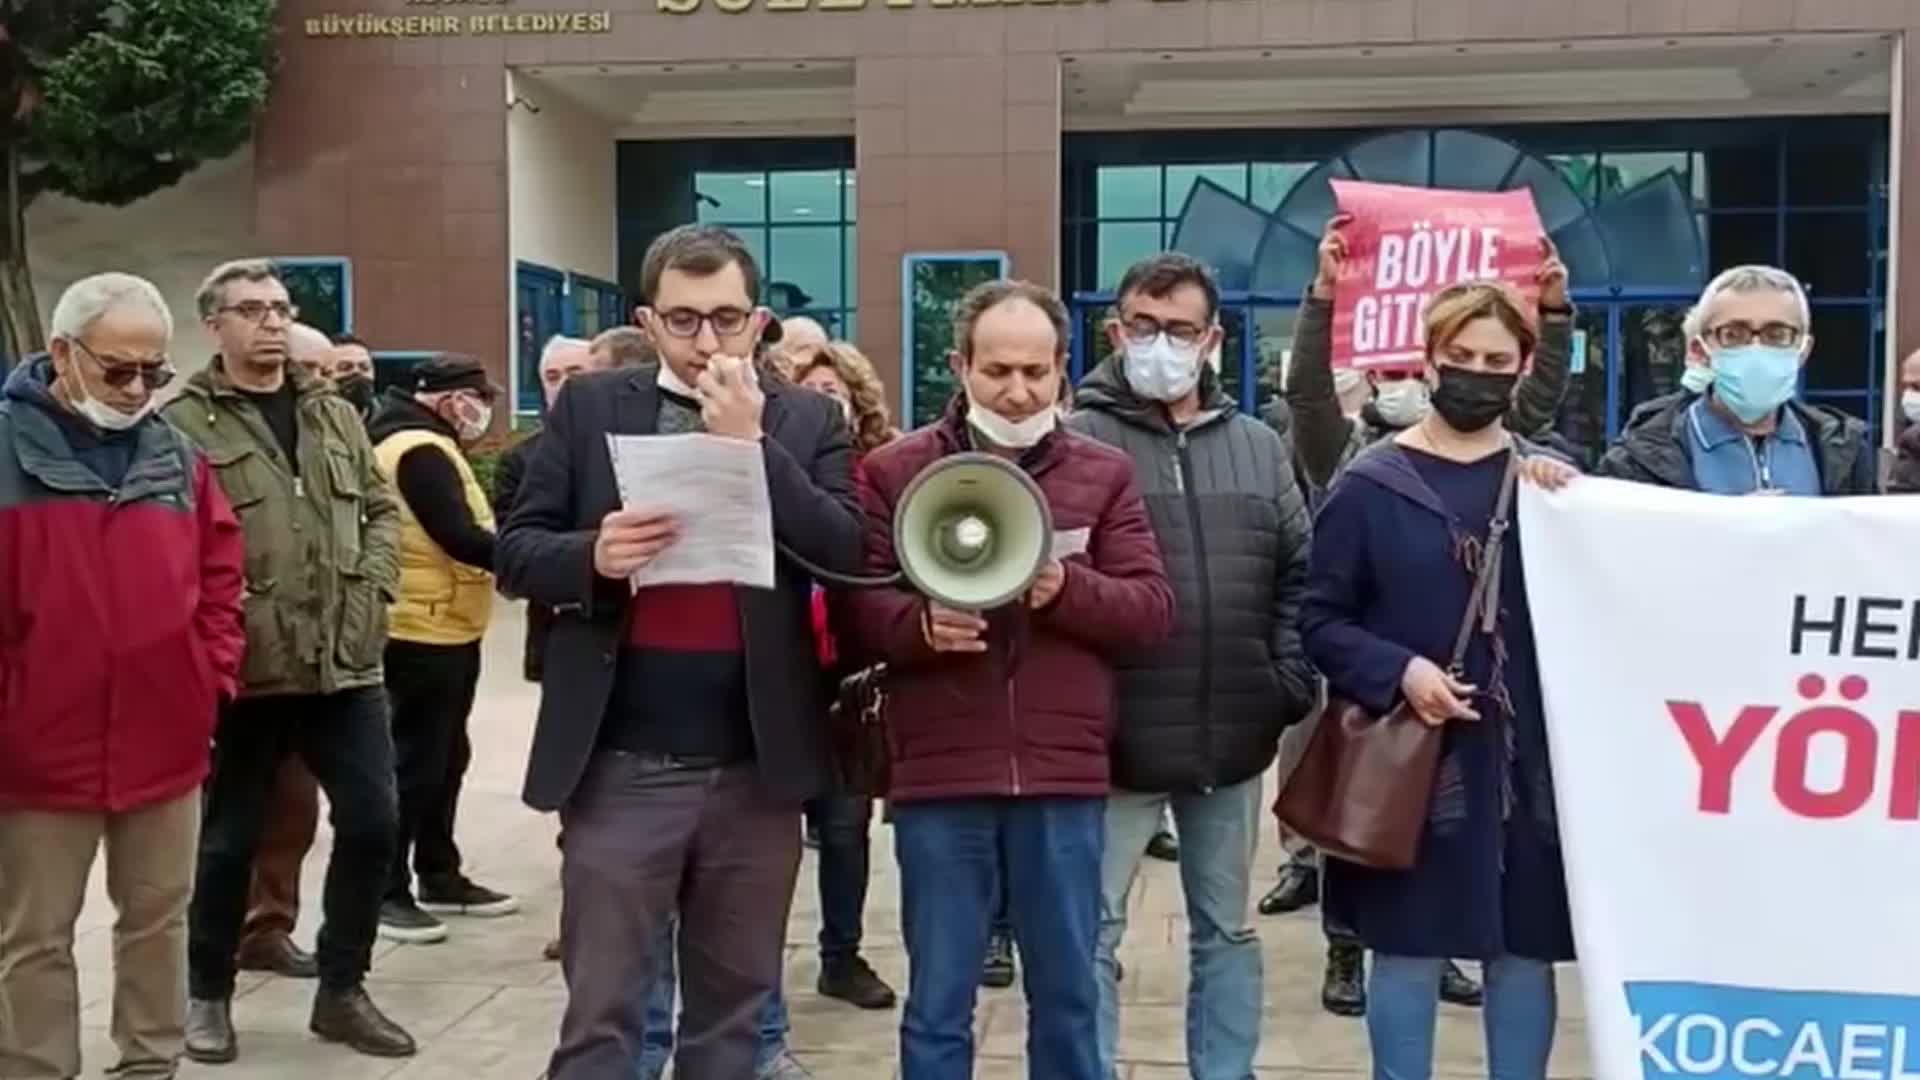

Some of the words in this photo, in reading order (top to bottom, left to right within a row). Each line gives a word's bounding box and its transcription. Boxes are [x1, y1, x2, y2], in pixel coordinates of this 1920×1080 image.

[1376, 221, 1501, 290] BÖYLE
[1790, 595, 1920, 659] HE
[1637, 1013, 1920, 1080] KOCAEL
